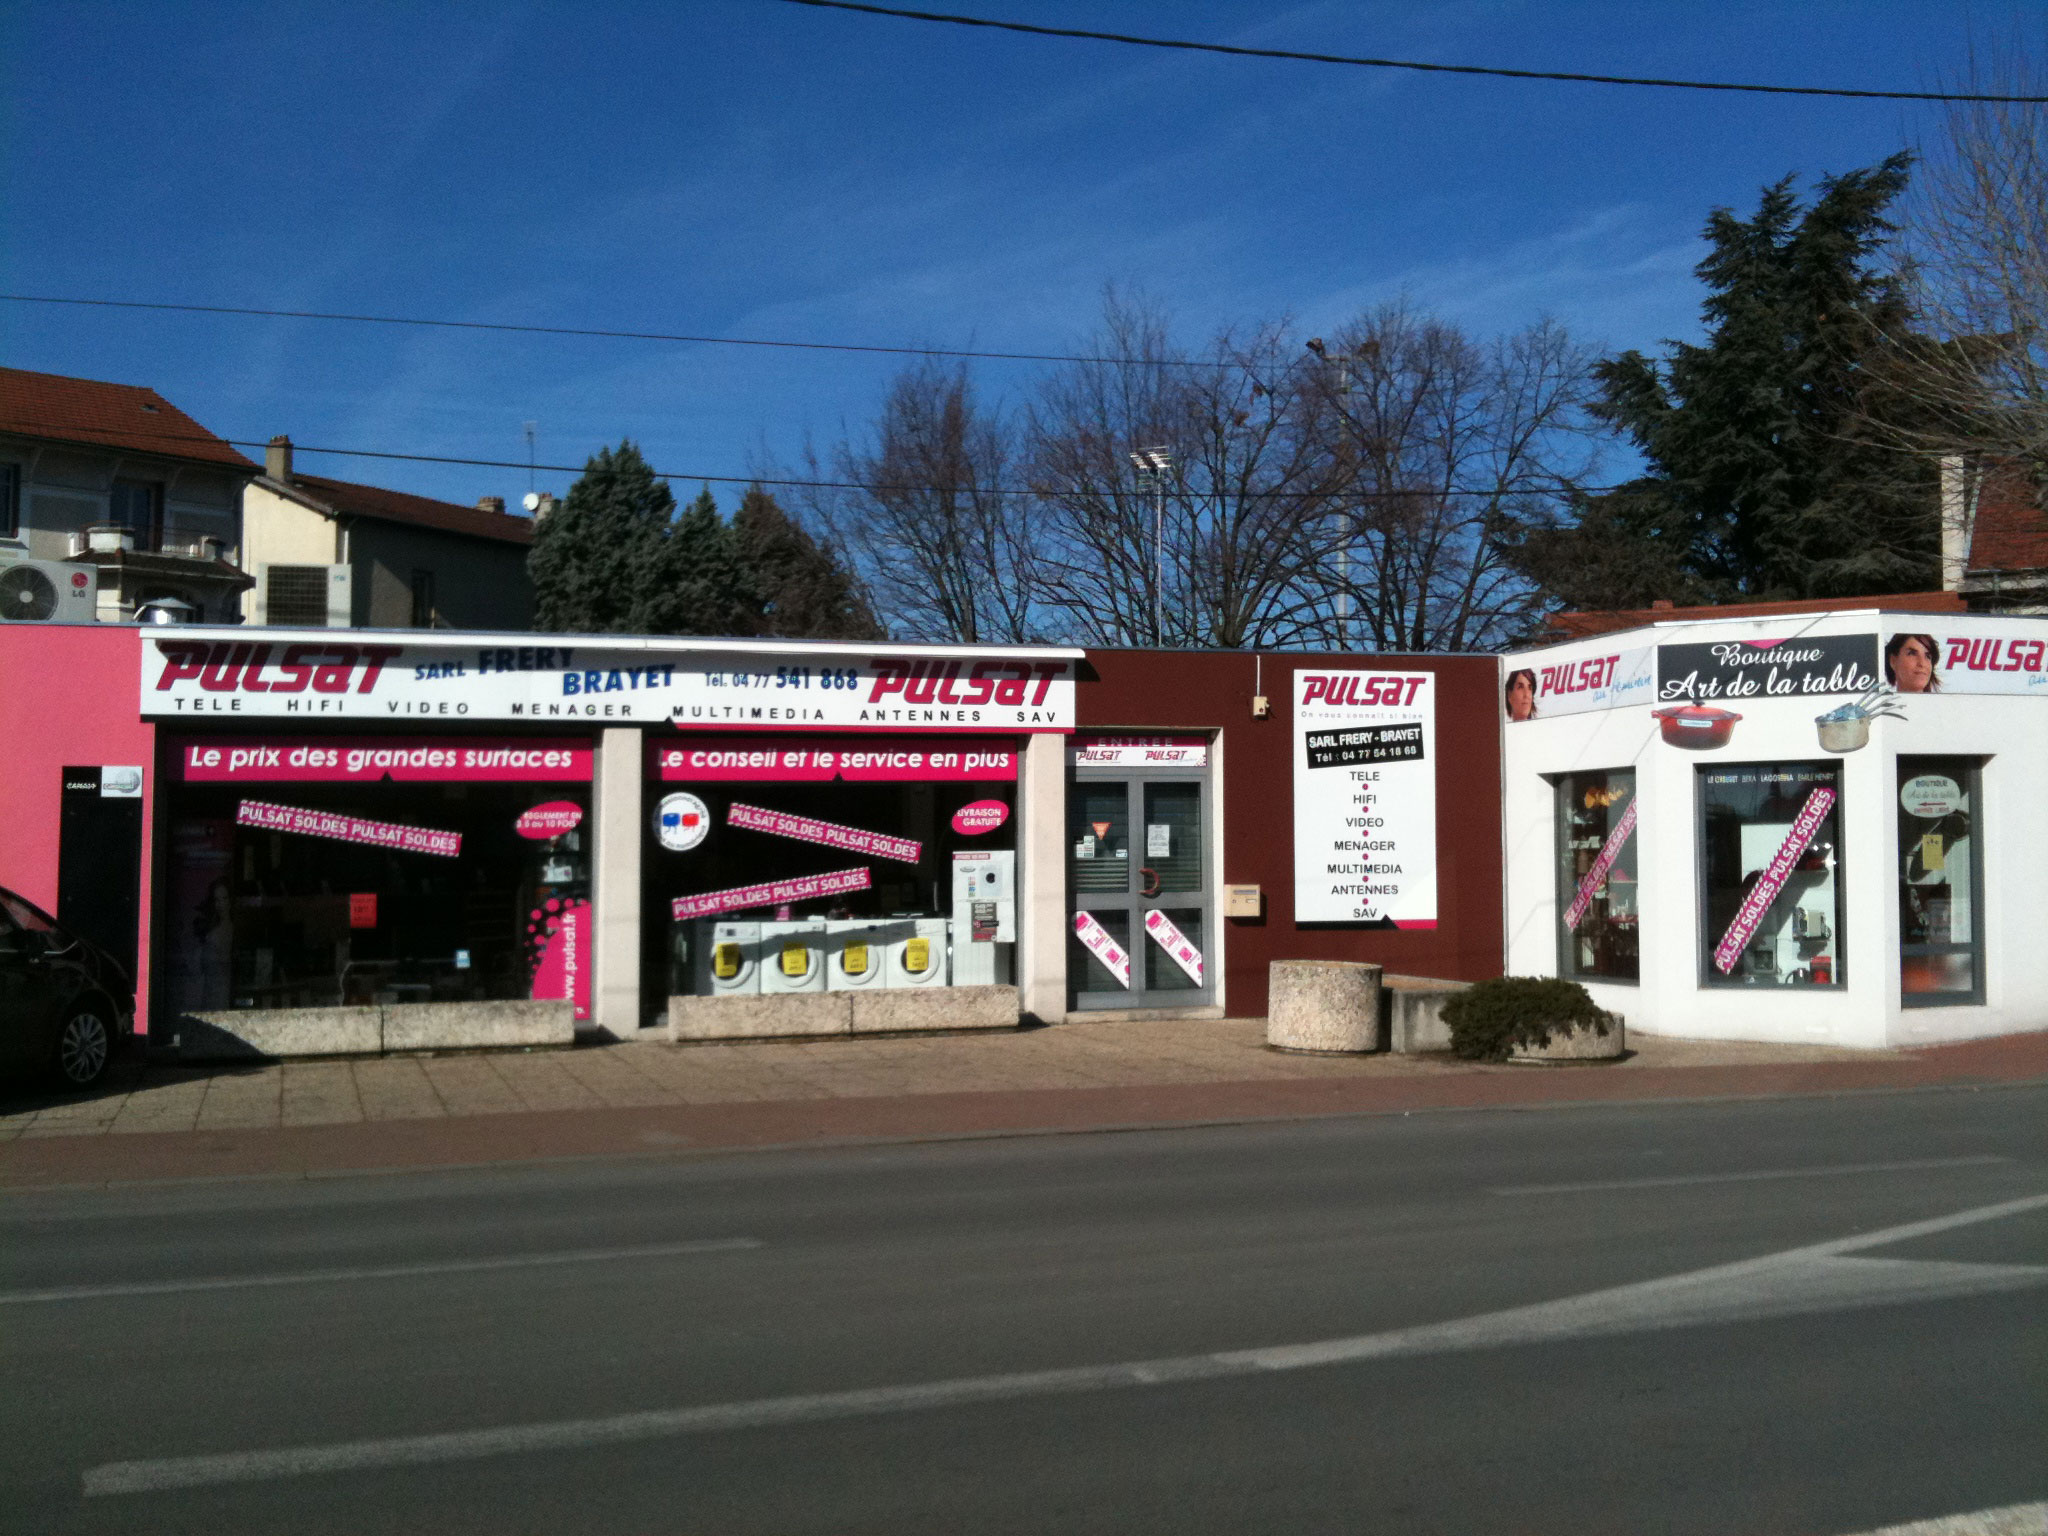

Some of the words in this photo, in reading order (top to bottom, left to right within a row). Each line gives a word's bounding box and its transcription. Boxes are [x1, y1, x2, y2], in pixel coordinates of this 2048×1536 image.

[72, 590, 86, 598] LG
[415, 661, 467, 681] SARL
[478, 648, 576, 675] FRERY
[1711, 643, 1825, 671] Boutique
[1945, 638, 2048, 672] PULSA
[563, 664, 676, 695] BRAYET
[733, 673, 749, 688] 04
[753, 674, 771, 689] 77
[776, 667, 810, 689] 541
[821, 668, 858, 690] 868
[1659, 670, 1722, 699] Art
[1726, 671, 1761, 697] de
[1766, 666, 1798, 695] la
[1802, 662, 1876, 692] table
[175, 698, 242, 711] TELE
[287, 700, 343, 711] HIFI
[388, 701, 469, 714] VIDEO
[512, 703, 631, 716] MENAGER
[672, 706, 825, 720] MULTIMEDIA
[860, 710, 981, 722] ANTENNES
[1017, 712, 1056, 723] SAV
[1309, 735, 1339, 749] SARL
[1339, 732, 1374, 746] FRERY
[1380, 728, 1421, 743] BRAYET
[190, 745, 222, 767] Le
[229, 745, 281, 772] prix
[289, 745, 338, 767] des
[346, 746, 457, 772] grandes
[690, 748, 777, 768] conseil
[783, 749, 808, 768] et
[812, 749, 835, 768] le
[840, 749, 923, 768] service
[929, 752, 958, 768] en
[964, 749, 1009, 772] plus
[1342, 751, 1355, 760] 04
[1358, 750, 1371, 759] 77
[1349, 771, 1381, 781] TELE
[1353, 795, 1377, 804] HIFI
[957, 808, 1001, 816] LIVRAISON
[1345, 818, 1384, 828] VIDEO
[239, 806, 294, 825] PULSAT
[294, 814, 348, 834] SOLDES
[351, 823, 404, 842] PULSAT
[405, 832, 457, 850] SOLDES
[730, 808, 775, 828] PULSAT
[777, 817, 823, 838] SOLDES
[826, 828, 870, 849] PULSAT
[871, 839, 917, 858] SOLDES
[1334, 841, 1396, 851] MENAGER
[1327, 864, 1403, 874] MULTIMEDIA
[1715, 924, 1747, 970] PULSAT
[1746, 880, 1775, 927] SOLDES
[1770, 836, 1802, 881] PULSAT
[1797, 790, 1830, 837] SOLDES
[675, 896, 721, 916] PULSAT
[723, 889, 771, 908] SOLDES
[773, 880, 819, 899] PULSAT
[821, 872, 867, 892] SOLDES
[1331, 885, 1399, 895] ANTENNES
[1353, 908, 1378, 918] SAV
